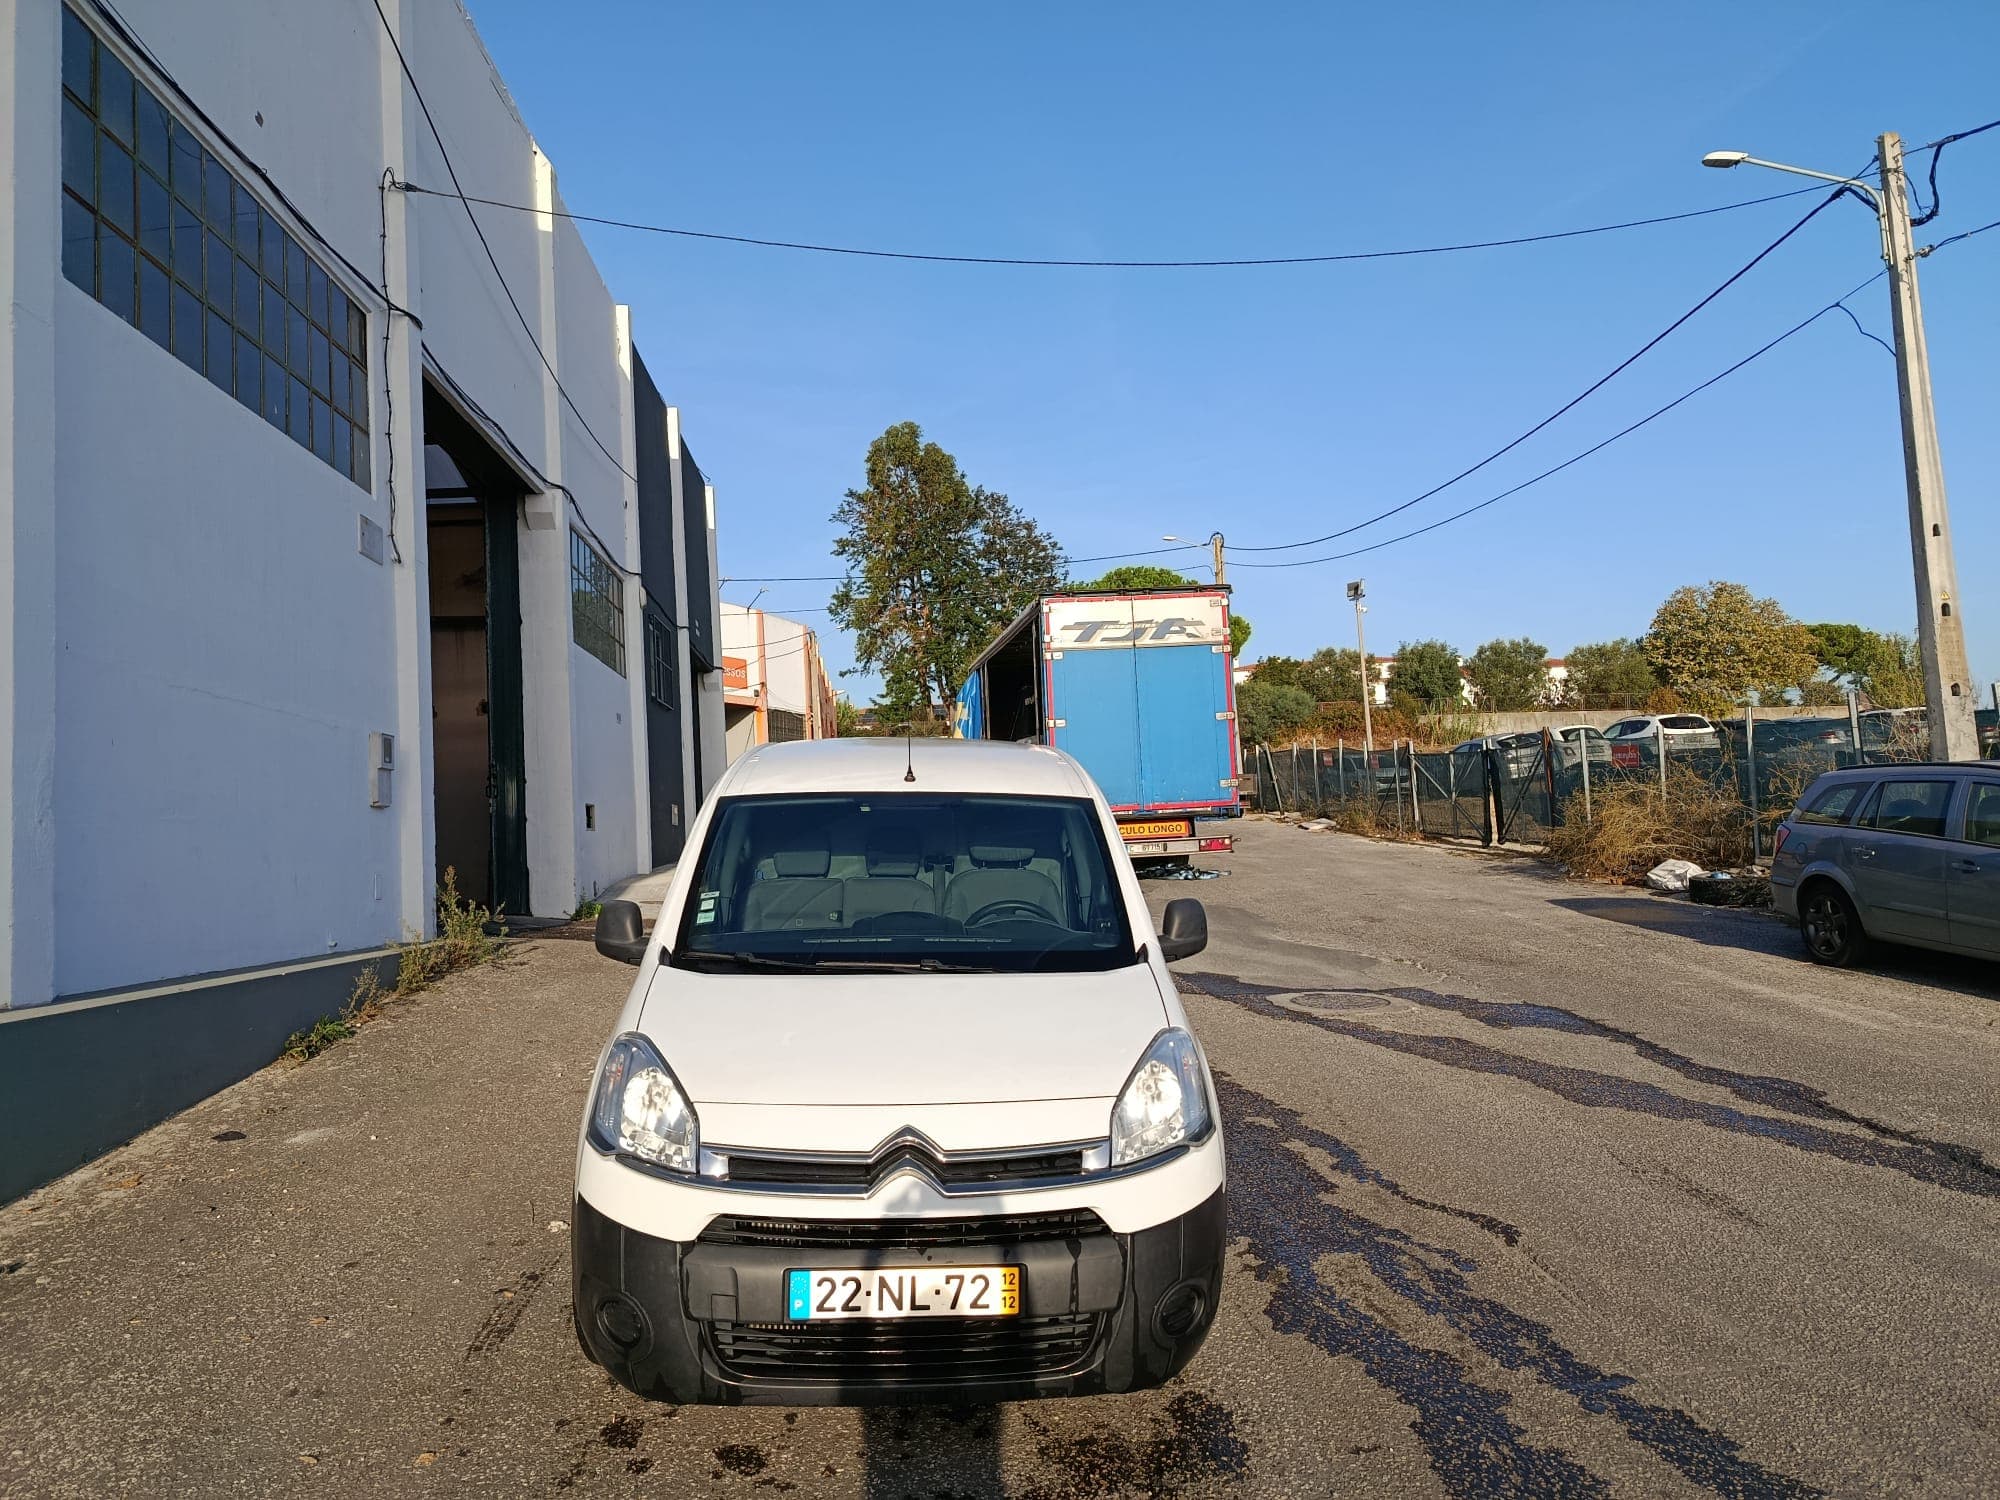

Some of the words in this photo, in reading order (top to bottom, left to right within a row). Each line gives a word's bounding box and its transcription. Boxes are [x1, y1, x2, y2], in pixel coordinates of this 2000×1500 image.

[1060, 617, 1206, 643] TJA
[1118, 825, 1146, 835] CULO
[1148, 823, 1183, 834] LONGO
[1001, 1272, 1016, 1285] 12
[794, 1299, 804, 1311] P
[1001, 1295, 1016, 1309] 12
